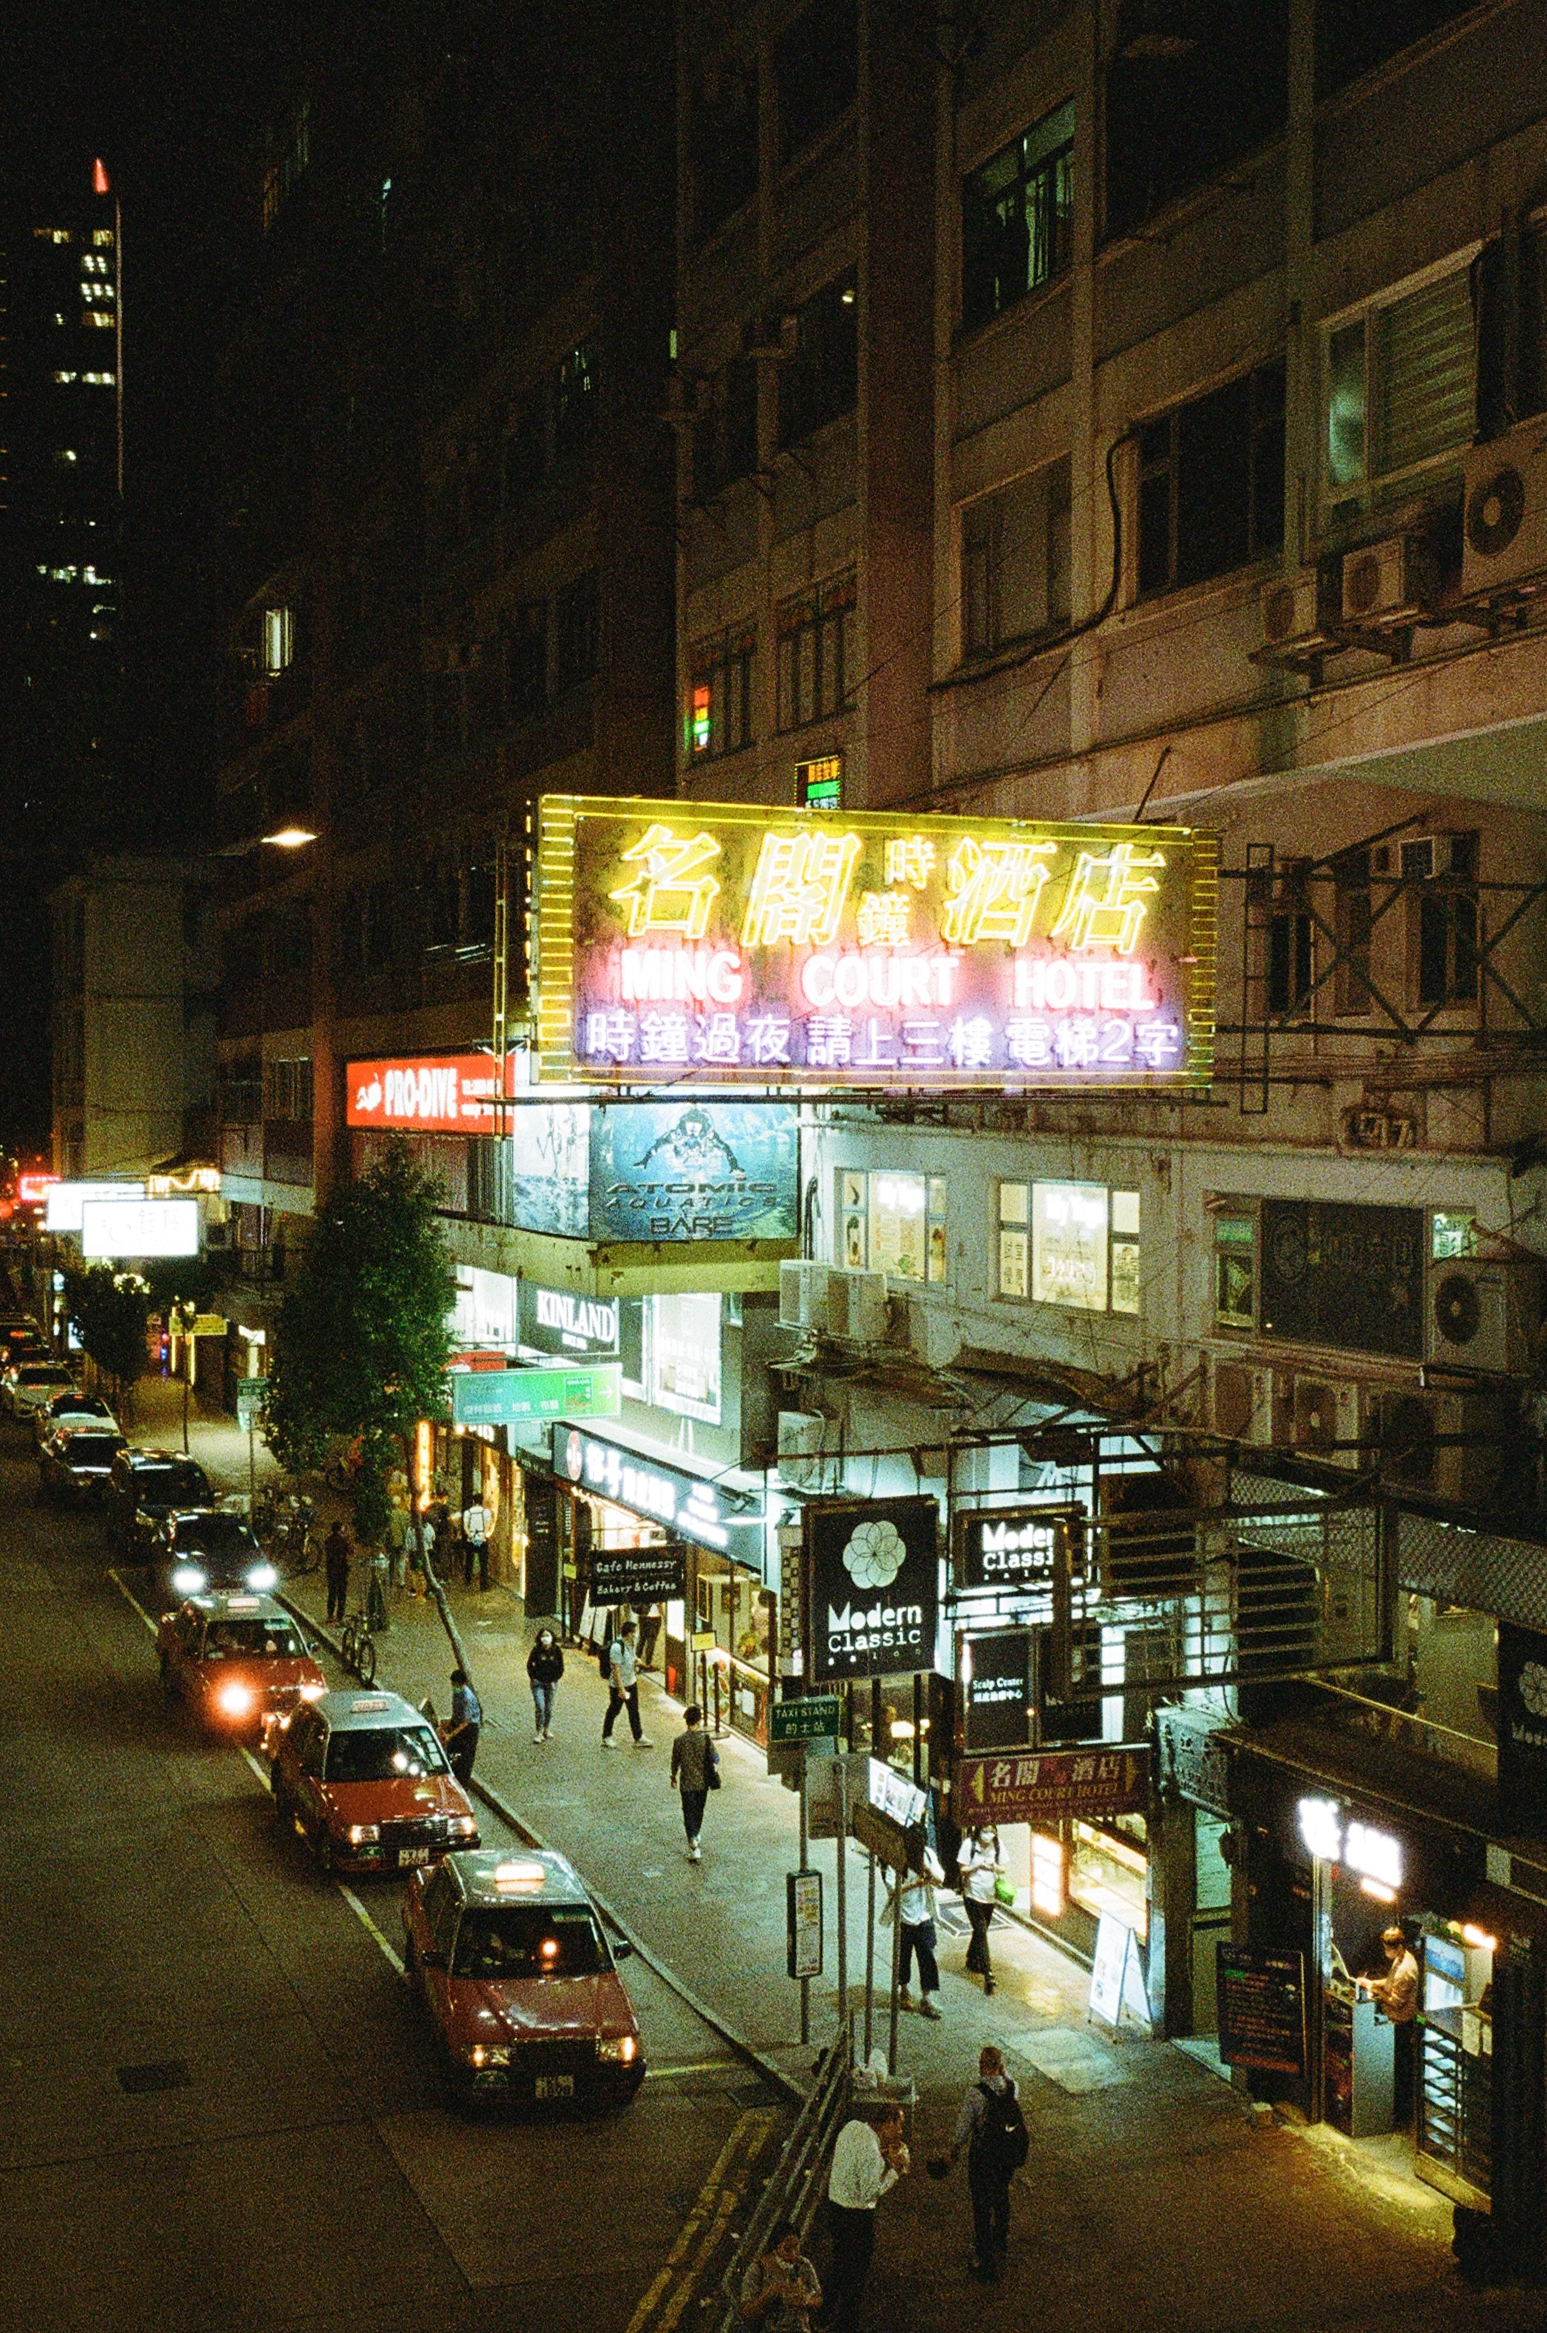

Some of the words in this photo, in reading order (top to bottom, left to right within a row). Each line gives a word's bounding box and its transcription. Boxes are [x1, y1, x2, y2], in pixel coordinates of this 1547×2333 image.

[944, 838, 1168, 954] 酒店
[620, 949, 742, 1003] MING
[802, 954, 962, 1007] COURT
[1014, 959, 1155, 1010] HOTEL
[587, 1013, 792, 1066] 時鐘過夜
[1005, 1018, 1178, 1069] 電梯2字
[384, 1067, 458, 1119] PRO-DIVE
[606, 1182, 777, 1194] ATOMIC
[606, 1197, 777, 1209] AQUATICS
[651, 1216, 733, 1234] BARE
[537, 1290, 616, 1342] KINLAND
[983, 1523, 1053, 1551] Moder
[625, 1559, 677, 1571] Hennessy
[983, 1552, 1053, 1570] Classi
[597, 1584, 631, 1596] Bakery
[643, 1581, 677, 1592] Coffee
[828, 1601, 922, 1632] Modern
[828, 1627, 922, 1653] Classic
[973, 1678, 994, 1691] Scalp
[997, 1677, 1024, 1689] Center
[775, 1707, 798, 1719] TAXI
[800, 1705, 836, 1717] STAND
[785, 1720, 825, 1735] 的士站
[989, 1759, 1041, 1789] 名閣
[1070, 1755, 1122, 1782] 酒店
[989, 1790, 1027, 1804] MING
[1028, 1787, 1074, 1801] COURT
[1077, 1782, 1120, 1798] HOTEL
